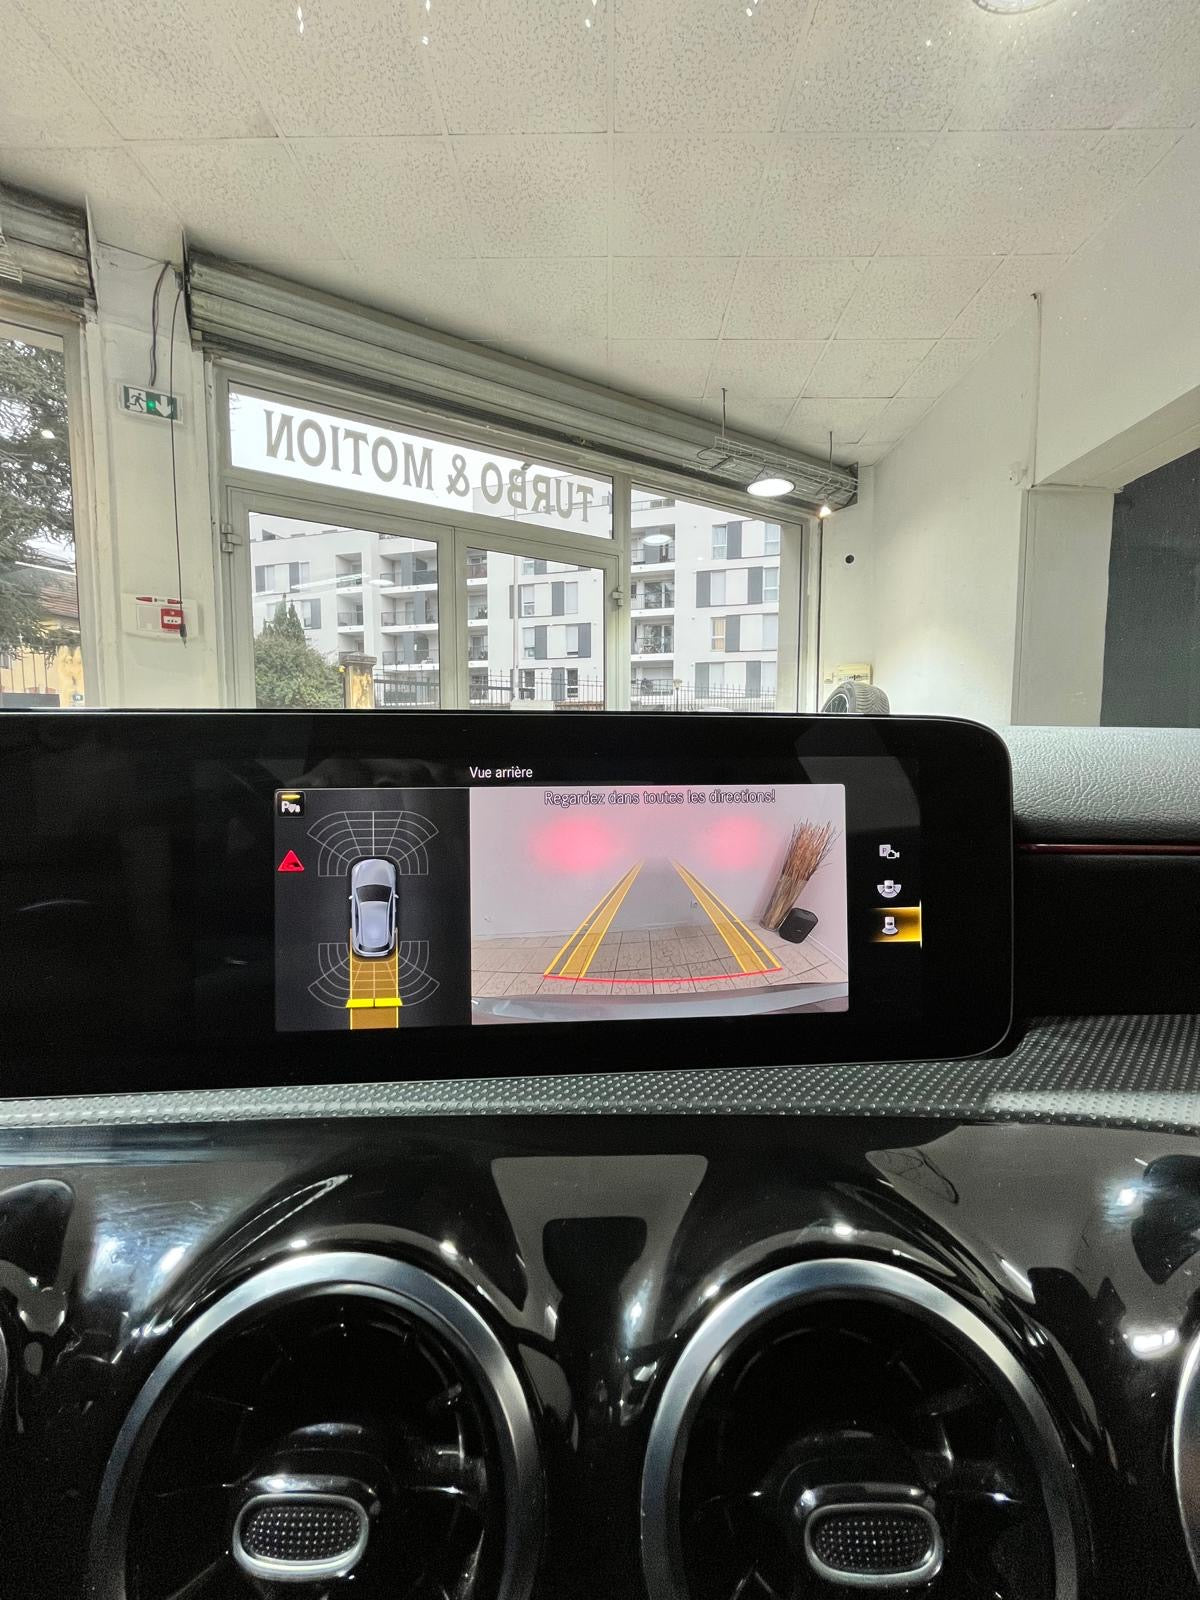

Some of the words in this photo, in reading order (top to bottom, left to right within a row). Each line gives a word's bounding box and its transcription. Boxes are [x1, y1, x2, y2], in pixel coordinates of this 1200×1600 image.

[469, 766, 492, 779] Vue
[495, 765, 533, 779] arrière
[544, 791, 606, 808] Regardez
[608, 790, 640, 805] dans
[642, 789, 684, 804] toutes
[686, 789, 706, 804] les
[708, 788, 776, 804] directions!
